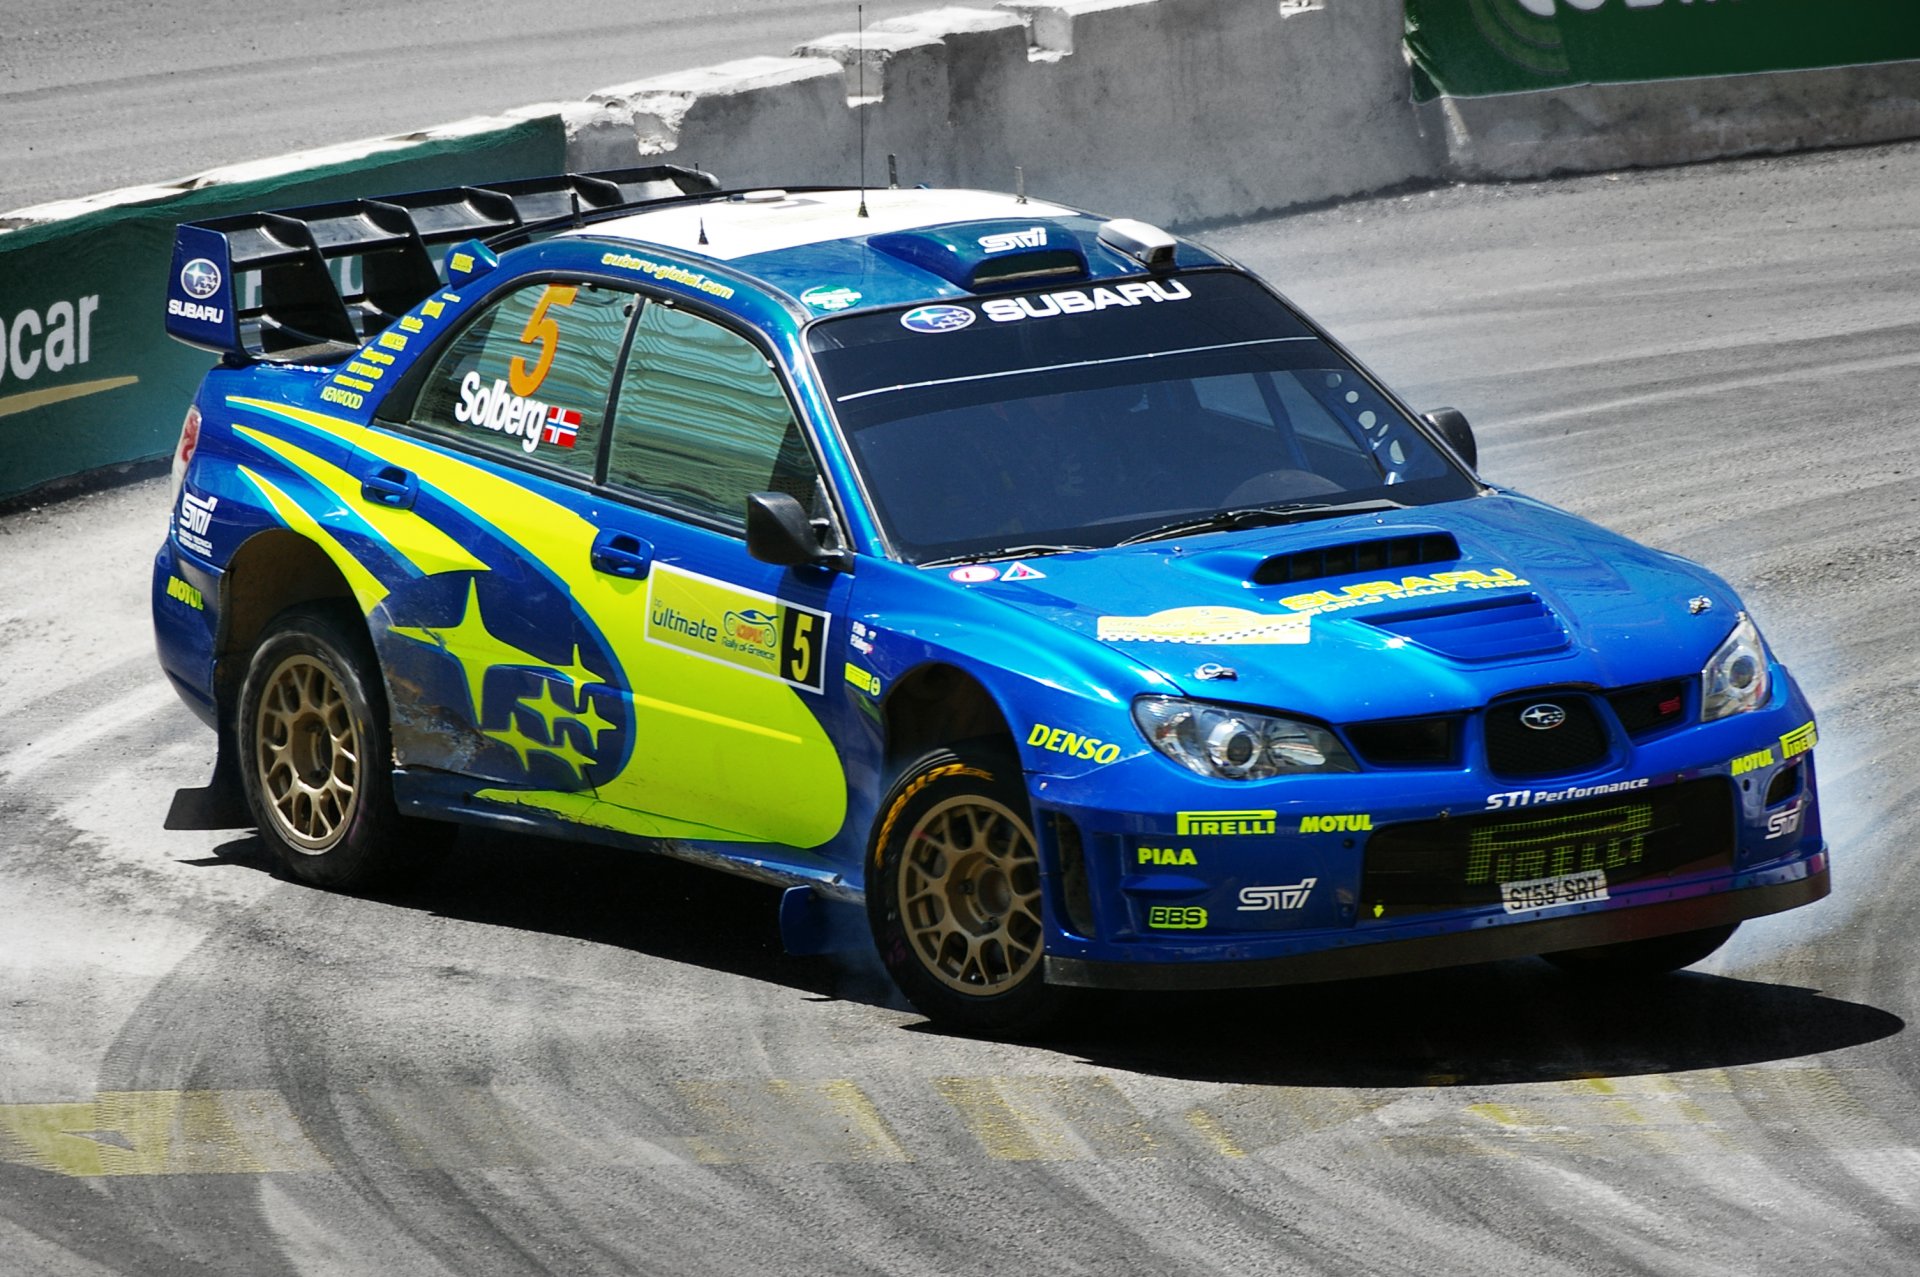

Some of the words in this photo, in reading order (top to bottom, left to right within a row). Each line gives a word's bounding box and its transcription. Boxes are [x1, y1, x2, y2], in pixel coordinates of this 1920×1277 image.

[168, 299, 224, 324] SUBARU
[983, 280, 1192, 322] SUBARU
[0, 293, 100, 382] car
[508, 284, 578, 397] 5
[320, 386, 364, 410] KENWOOD
[455, 371, 549, 453] Solberg
[166, 575, 204, 611] MOTUL
[1279, 568, 1517, 611] SUBARU
[652, 607, 718, 643] ultimate
[791, 613, 814, 682] 5
[1027, 723, 1121, 764] DENSO
[1777, 720, 1819, 760] PIRELLI
[1731, 748, 1774, 776] MOTUL
[1485, 790, 1531, 810] STI
[1533, 778, 1650, 804] Performance
[1176, 810, 1277, 836] PIRELLI
[1299, 815, 1374, 833] MOTUL
[1138, 848, 1198, 865] PIAA
[1465, 803, 1652, 885] PIRELLI
[1149, 907, 1208, 929] BBS
